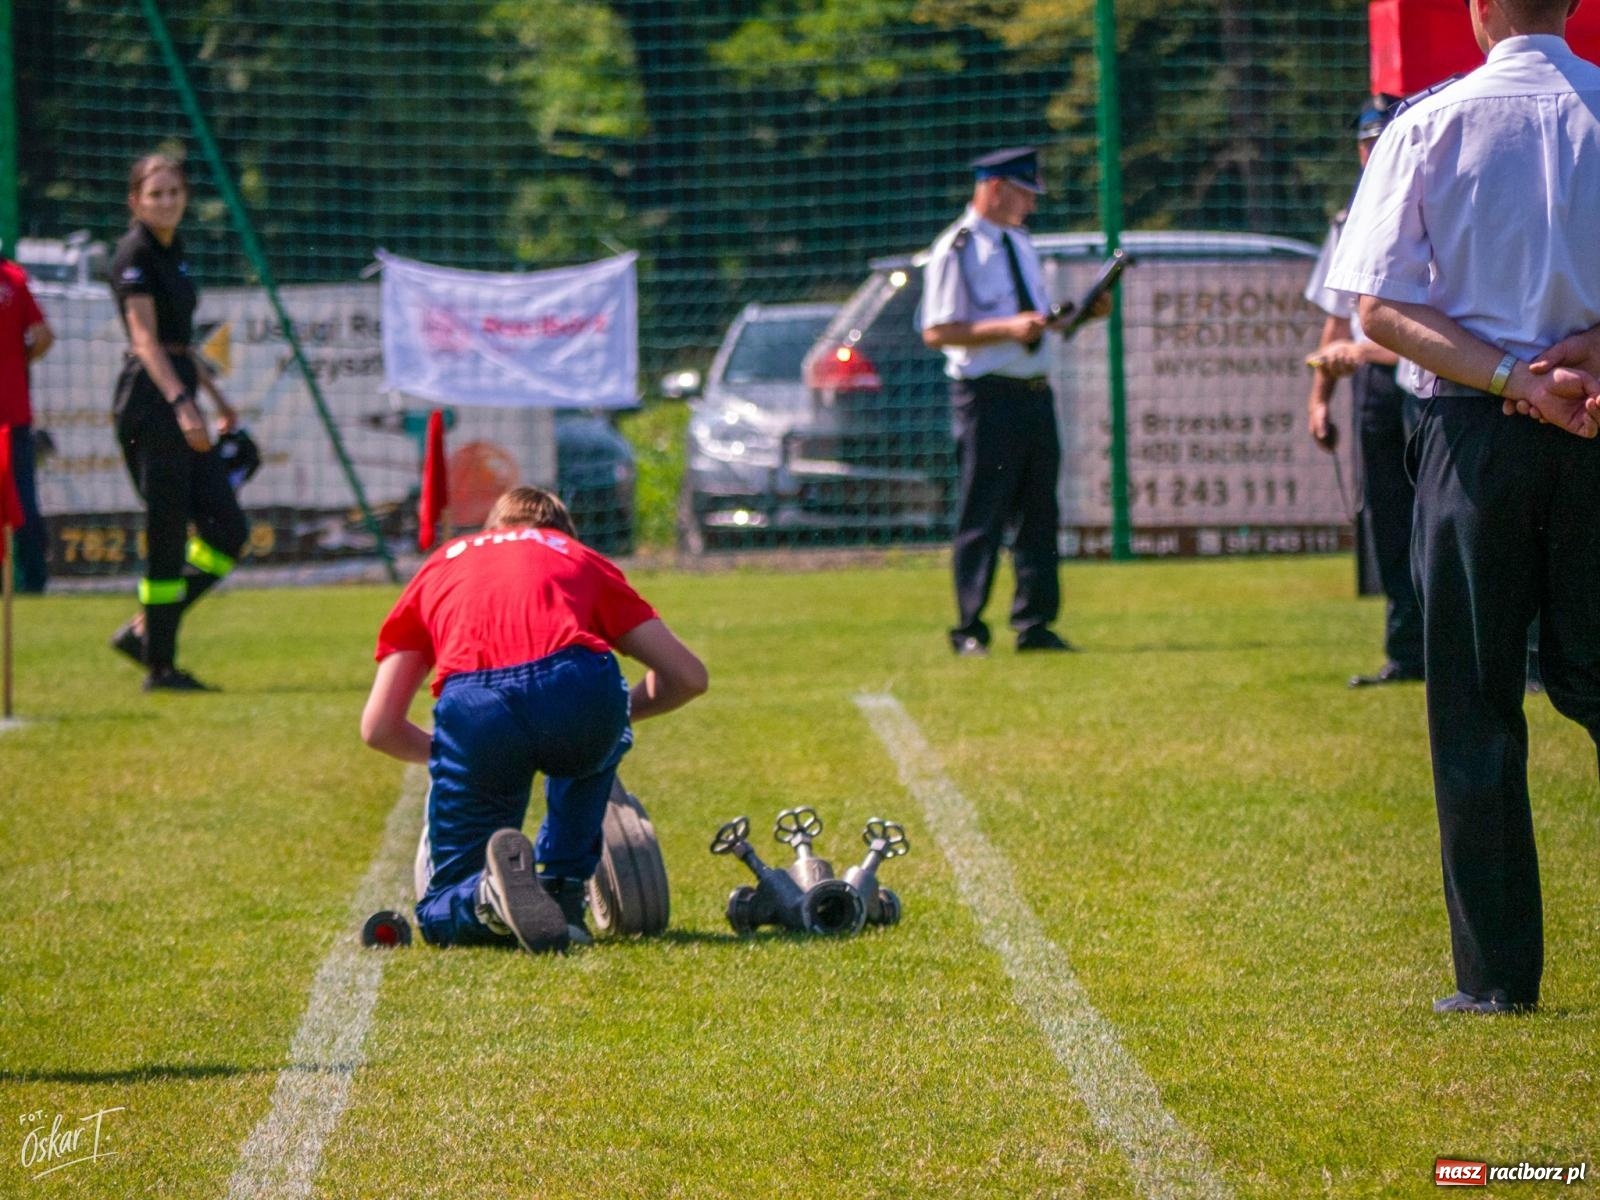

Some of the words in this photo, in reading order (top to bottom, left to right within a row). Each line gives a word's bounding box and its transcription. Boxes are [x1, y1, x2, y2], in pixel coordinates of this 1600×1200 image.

[1171, 475, 1230, 507] 243
[1243, 476, 1298, 507] 111
[60, 525, 127, 563] 782
